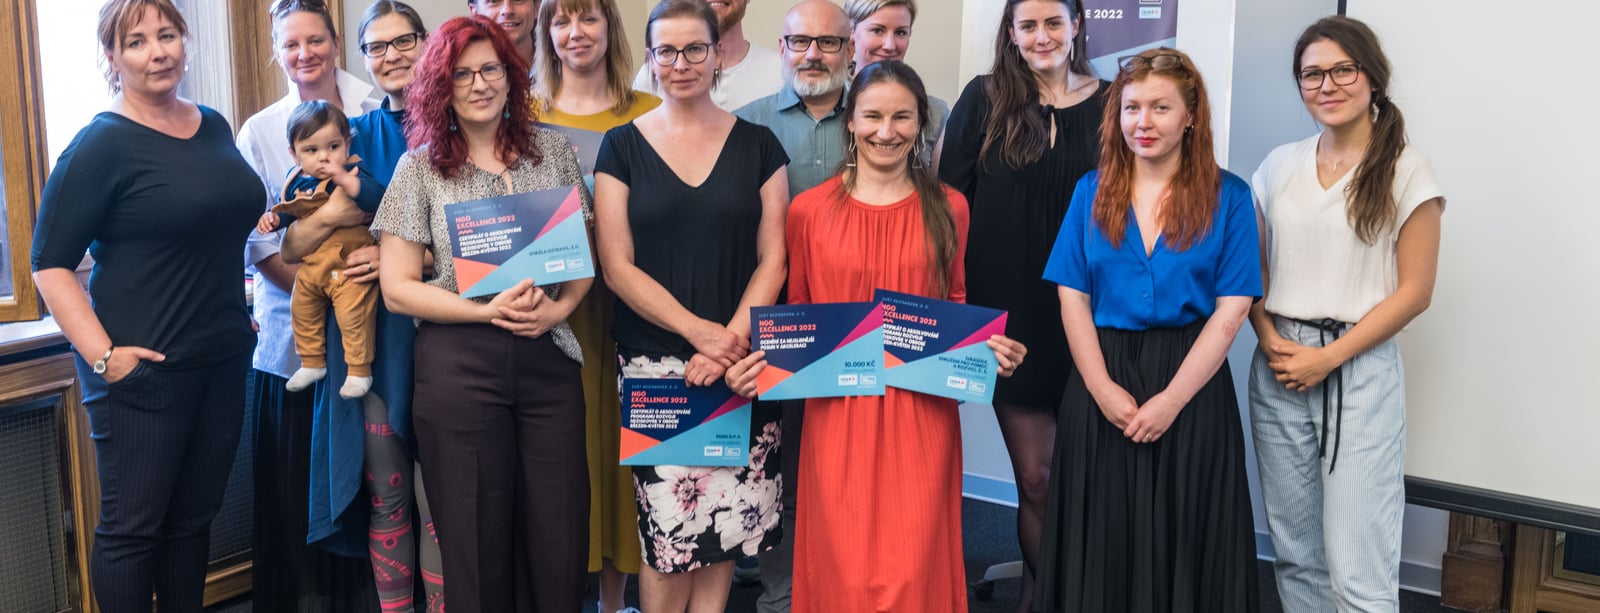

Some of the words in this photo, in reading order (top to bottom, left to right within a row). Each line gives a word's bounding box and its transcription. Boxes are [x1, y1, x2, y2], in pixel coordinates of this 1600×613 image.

[1094, 9, 1123, 19] 2022
[456, 214, 471, 224] NGO
[456, 217, 496, 230] EXCELLENCE
[497, 214, 516, 224] 2022
[882, 310, 918, 323] XCELLENCE
[920, 316, 938, 326] 2022
[760, 324, 798, 332] EXCELLENCE
[799, 324, 816, 332] 2022
